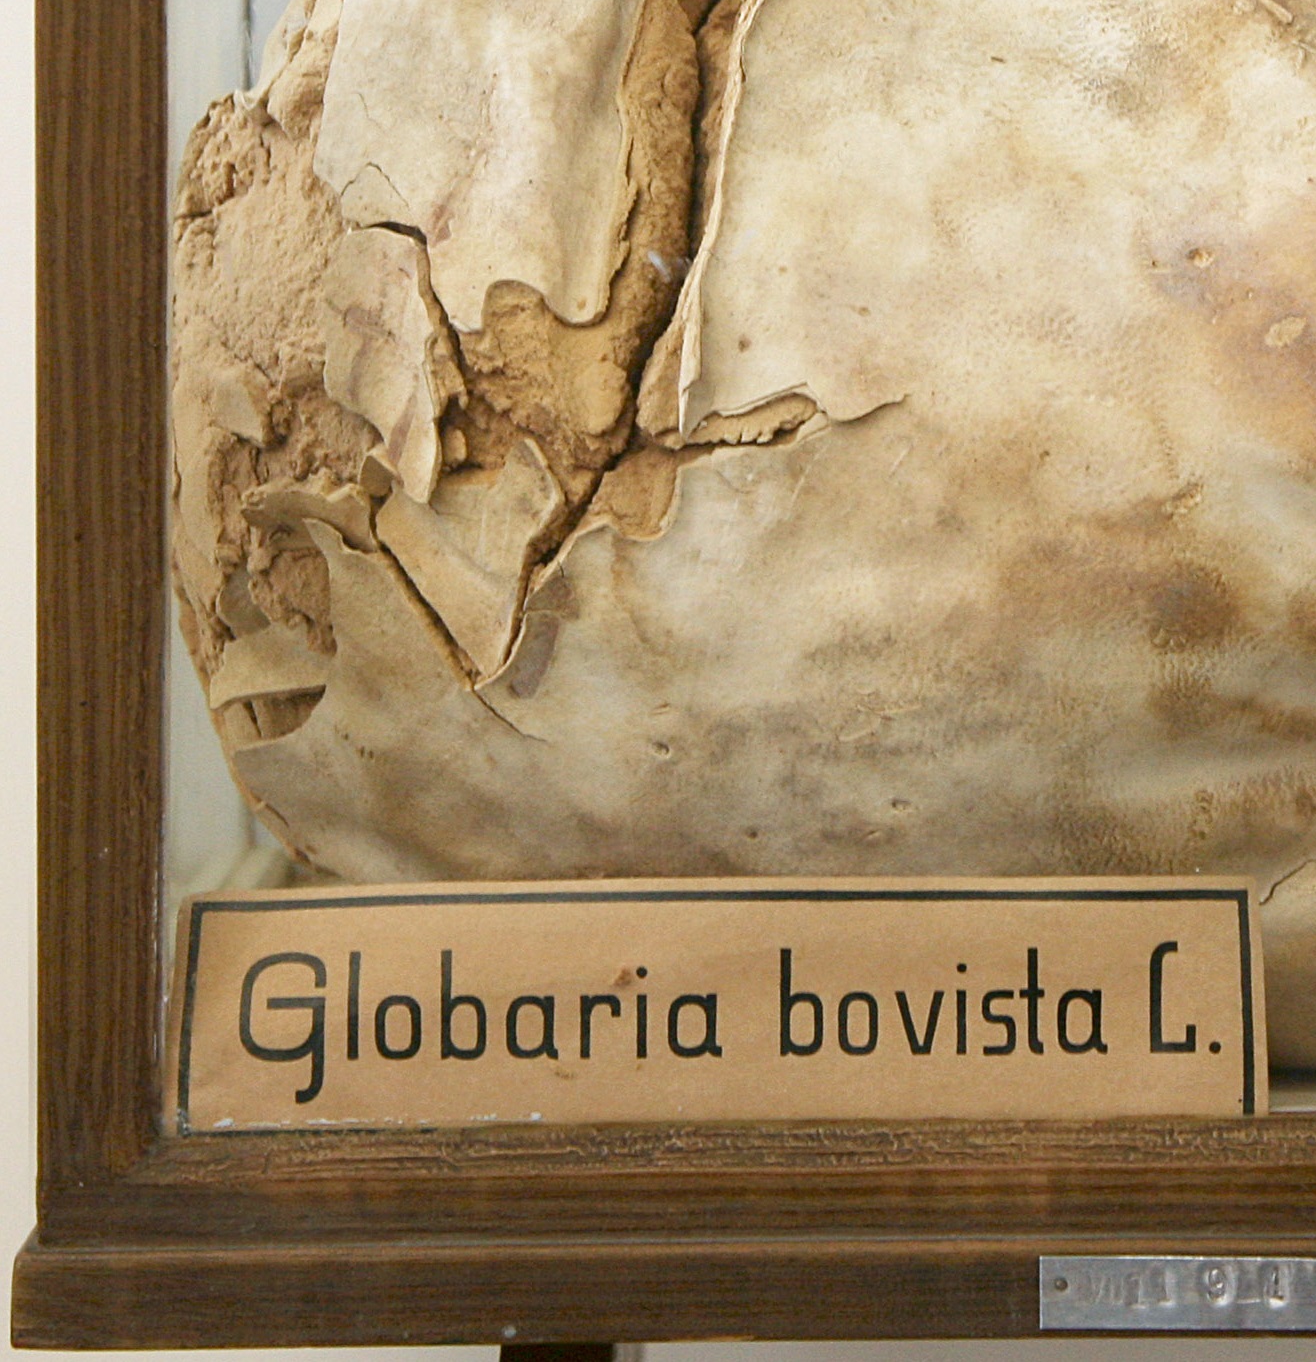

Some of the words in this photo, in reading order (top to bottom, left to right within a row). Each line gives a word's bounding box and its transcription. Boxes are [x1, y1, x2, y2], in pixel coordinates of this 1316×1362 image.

[236, 946, 724, 1104] Globaria
[777, 946, 1108, 1058] bovista
[1148, 940, 1223, 1055] L.
